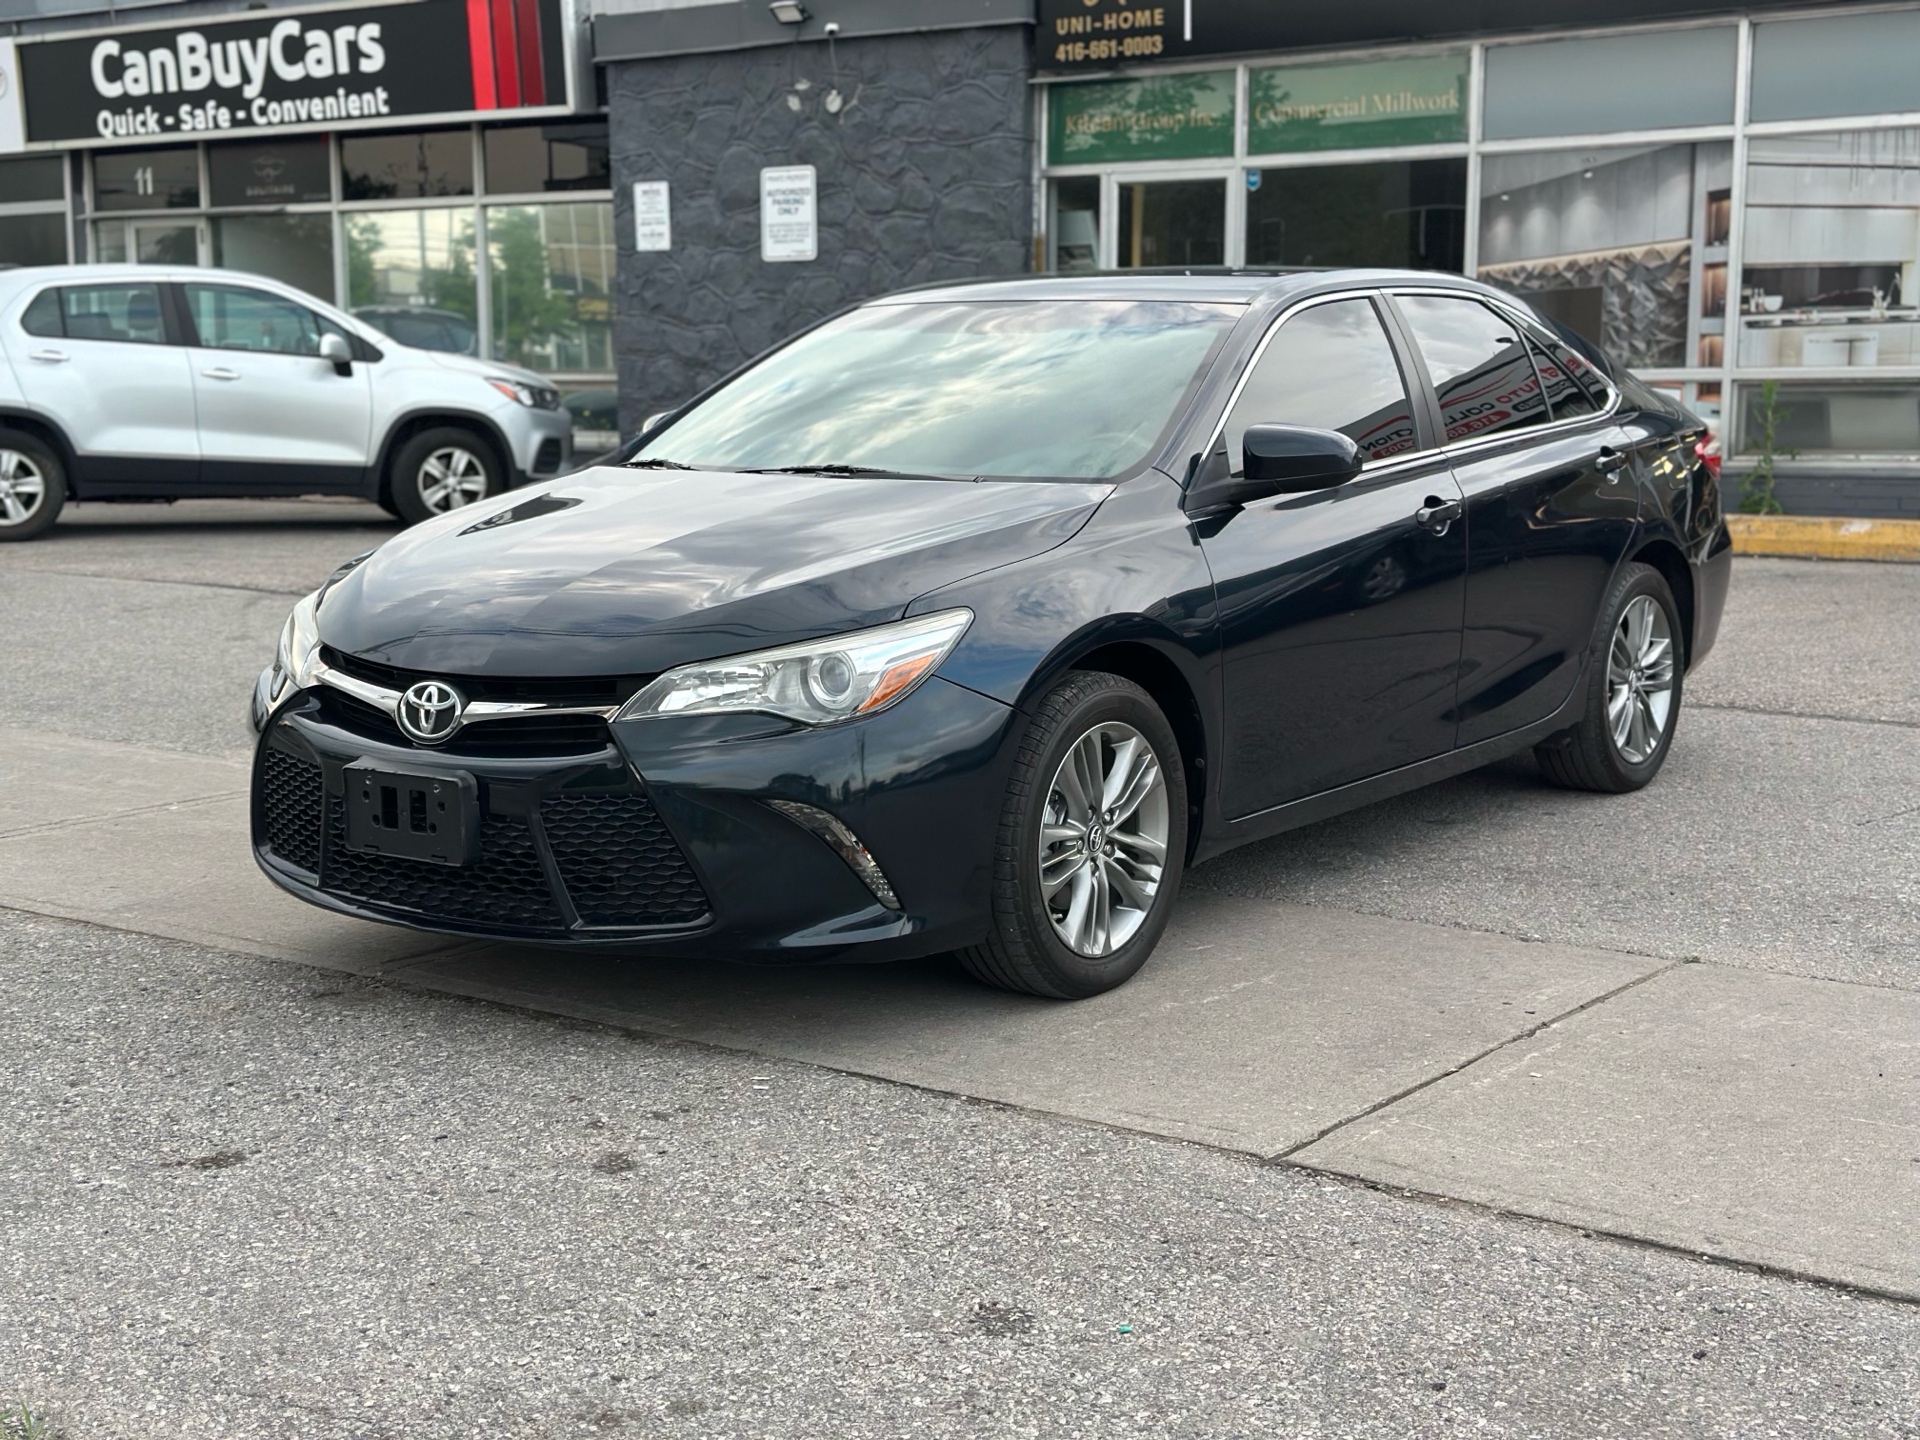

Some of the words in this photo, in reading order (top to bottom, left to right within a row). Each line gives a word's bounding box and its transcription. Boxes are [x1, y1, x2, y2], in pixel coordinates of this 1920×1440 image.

[1056, 8, 1164, 36] UNI-HOME
[90, 18, 386, 99] CanBuyCars
[1055, 34, 1163, 62] 416-661-0003
[97, 105, 161, 139] Quick
[178, 100, 231, 132] Safe
[251, 86, 390, 125] Convenient
[1254, 95, 1366, 123] Commercial
[1372, 88, 1459, 115] Millwork
[1128, 110, 1185, 134] Group
[134, 166, 154, 196] 11
